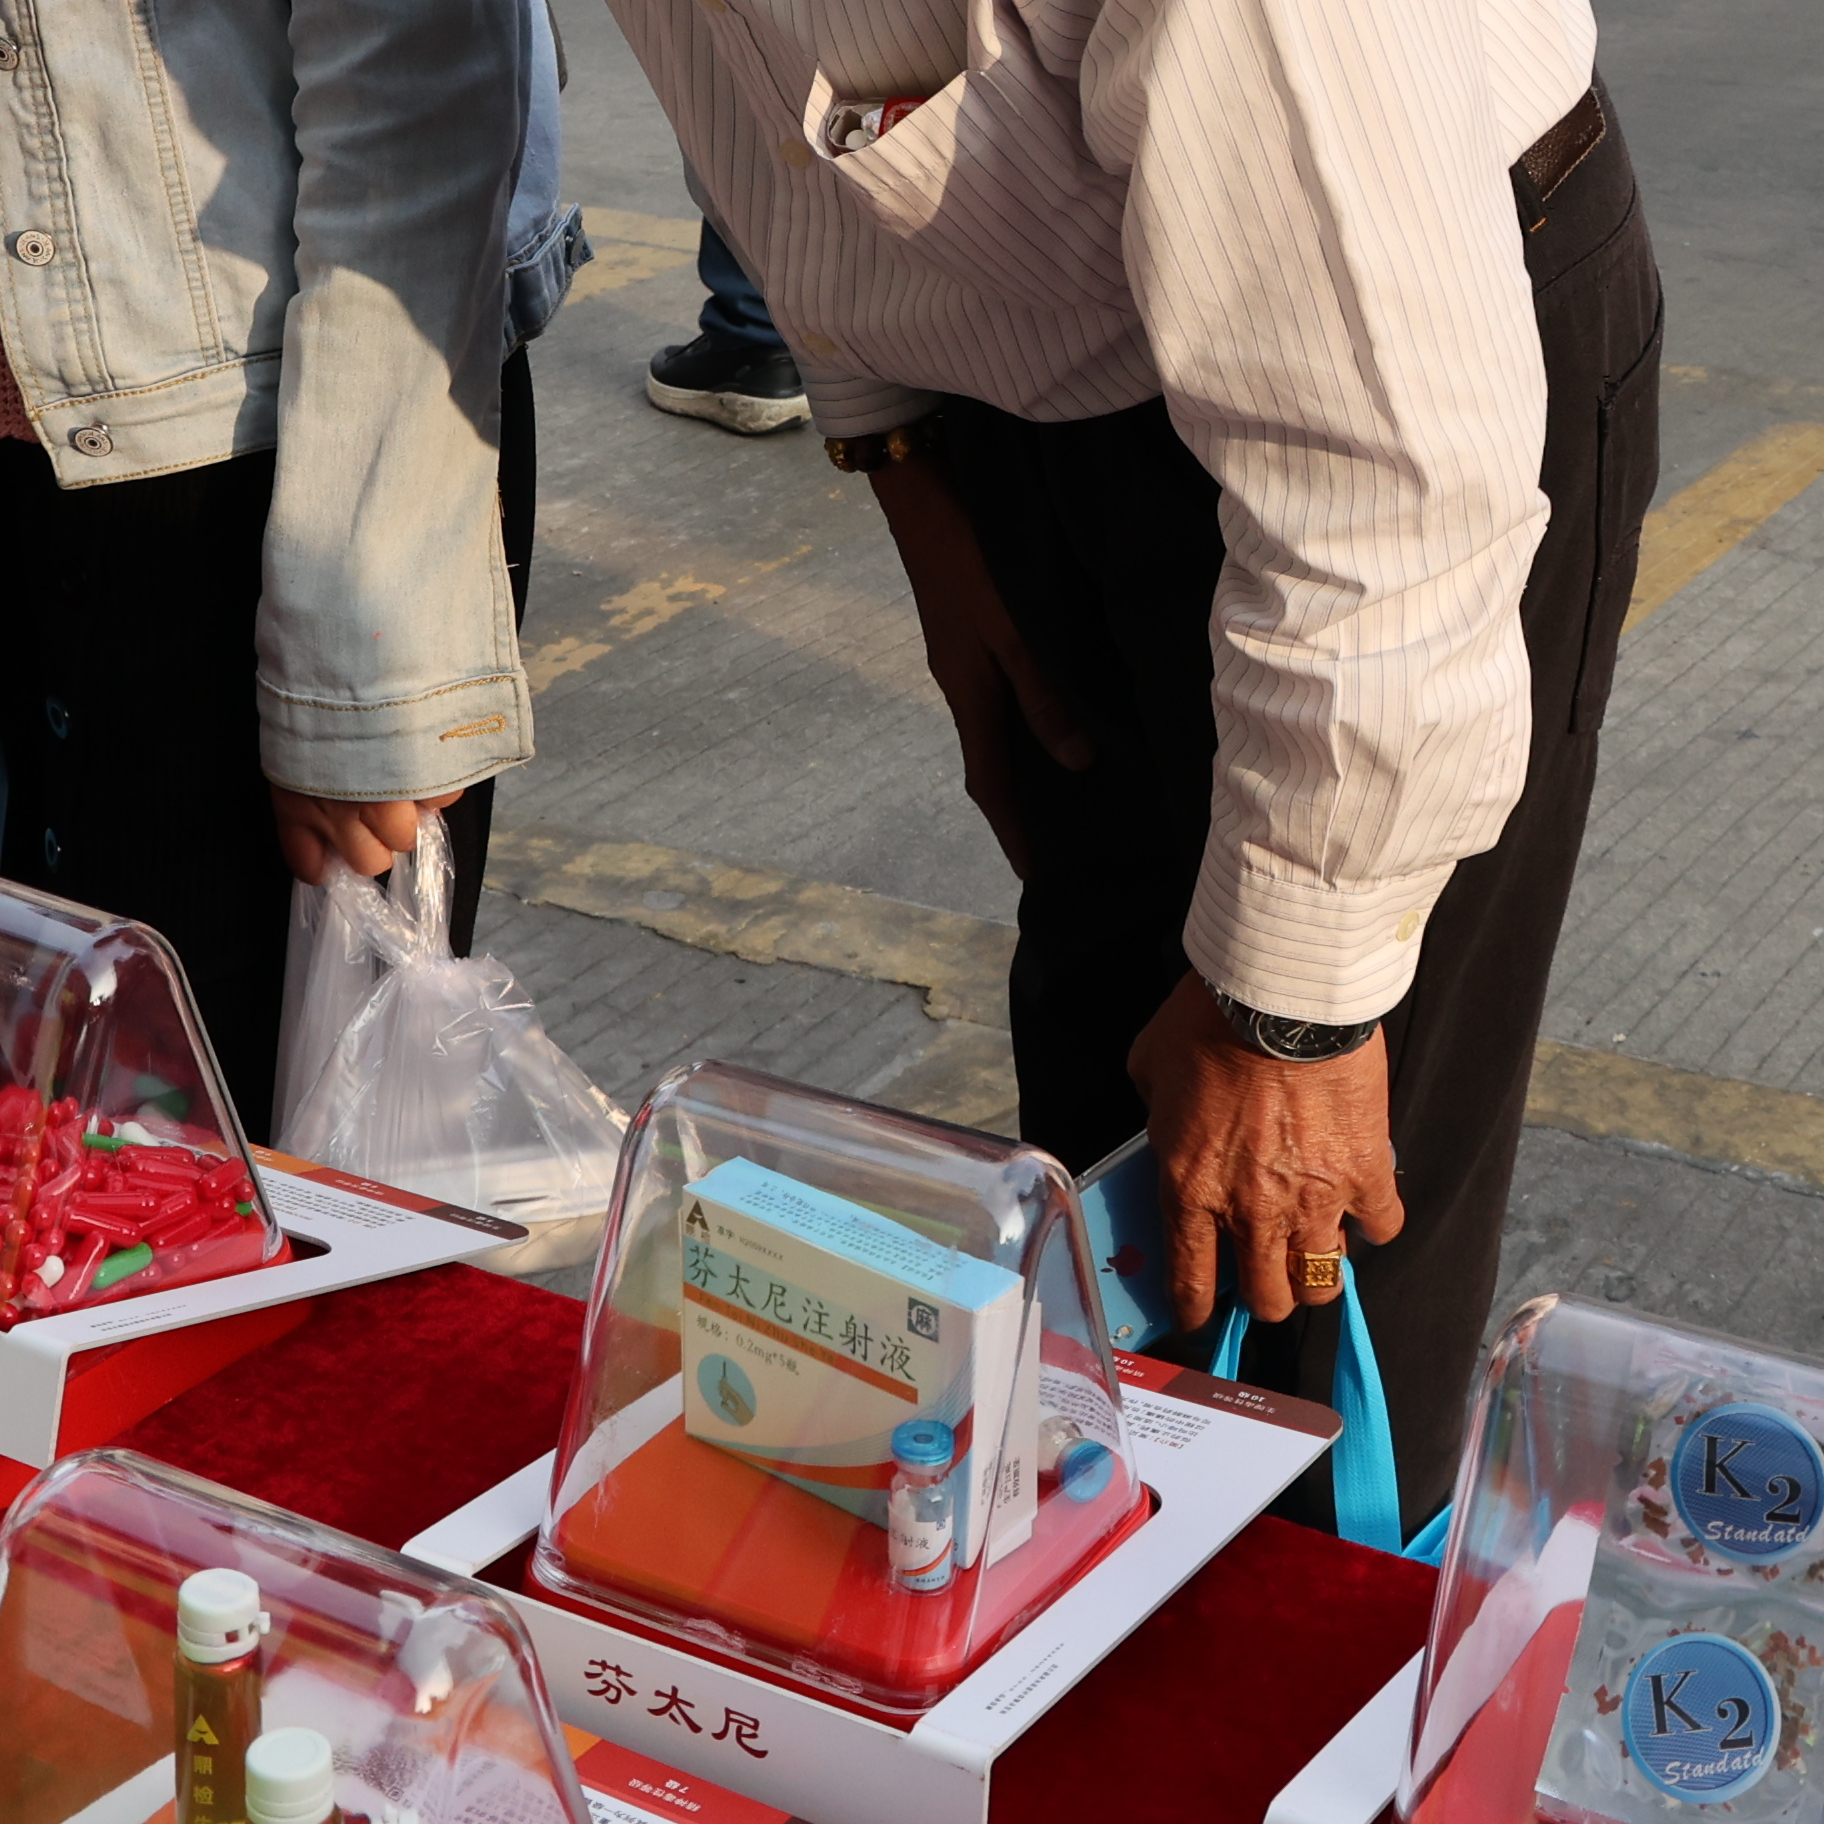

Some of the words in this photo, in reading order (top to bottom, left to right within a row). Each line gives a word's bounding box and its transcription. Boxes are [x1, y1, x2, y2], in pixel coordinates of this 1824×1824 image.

[688, 1243, 917, 1382] 芬太尼注射液
[582, 1656, 769, 1760] 芬太尼
